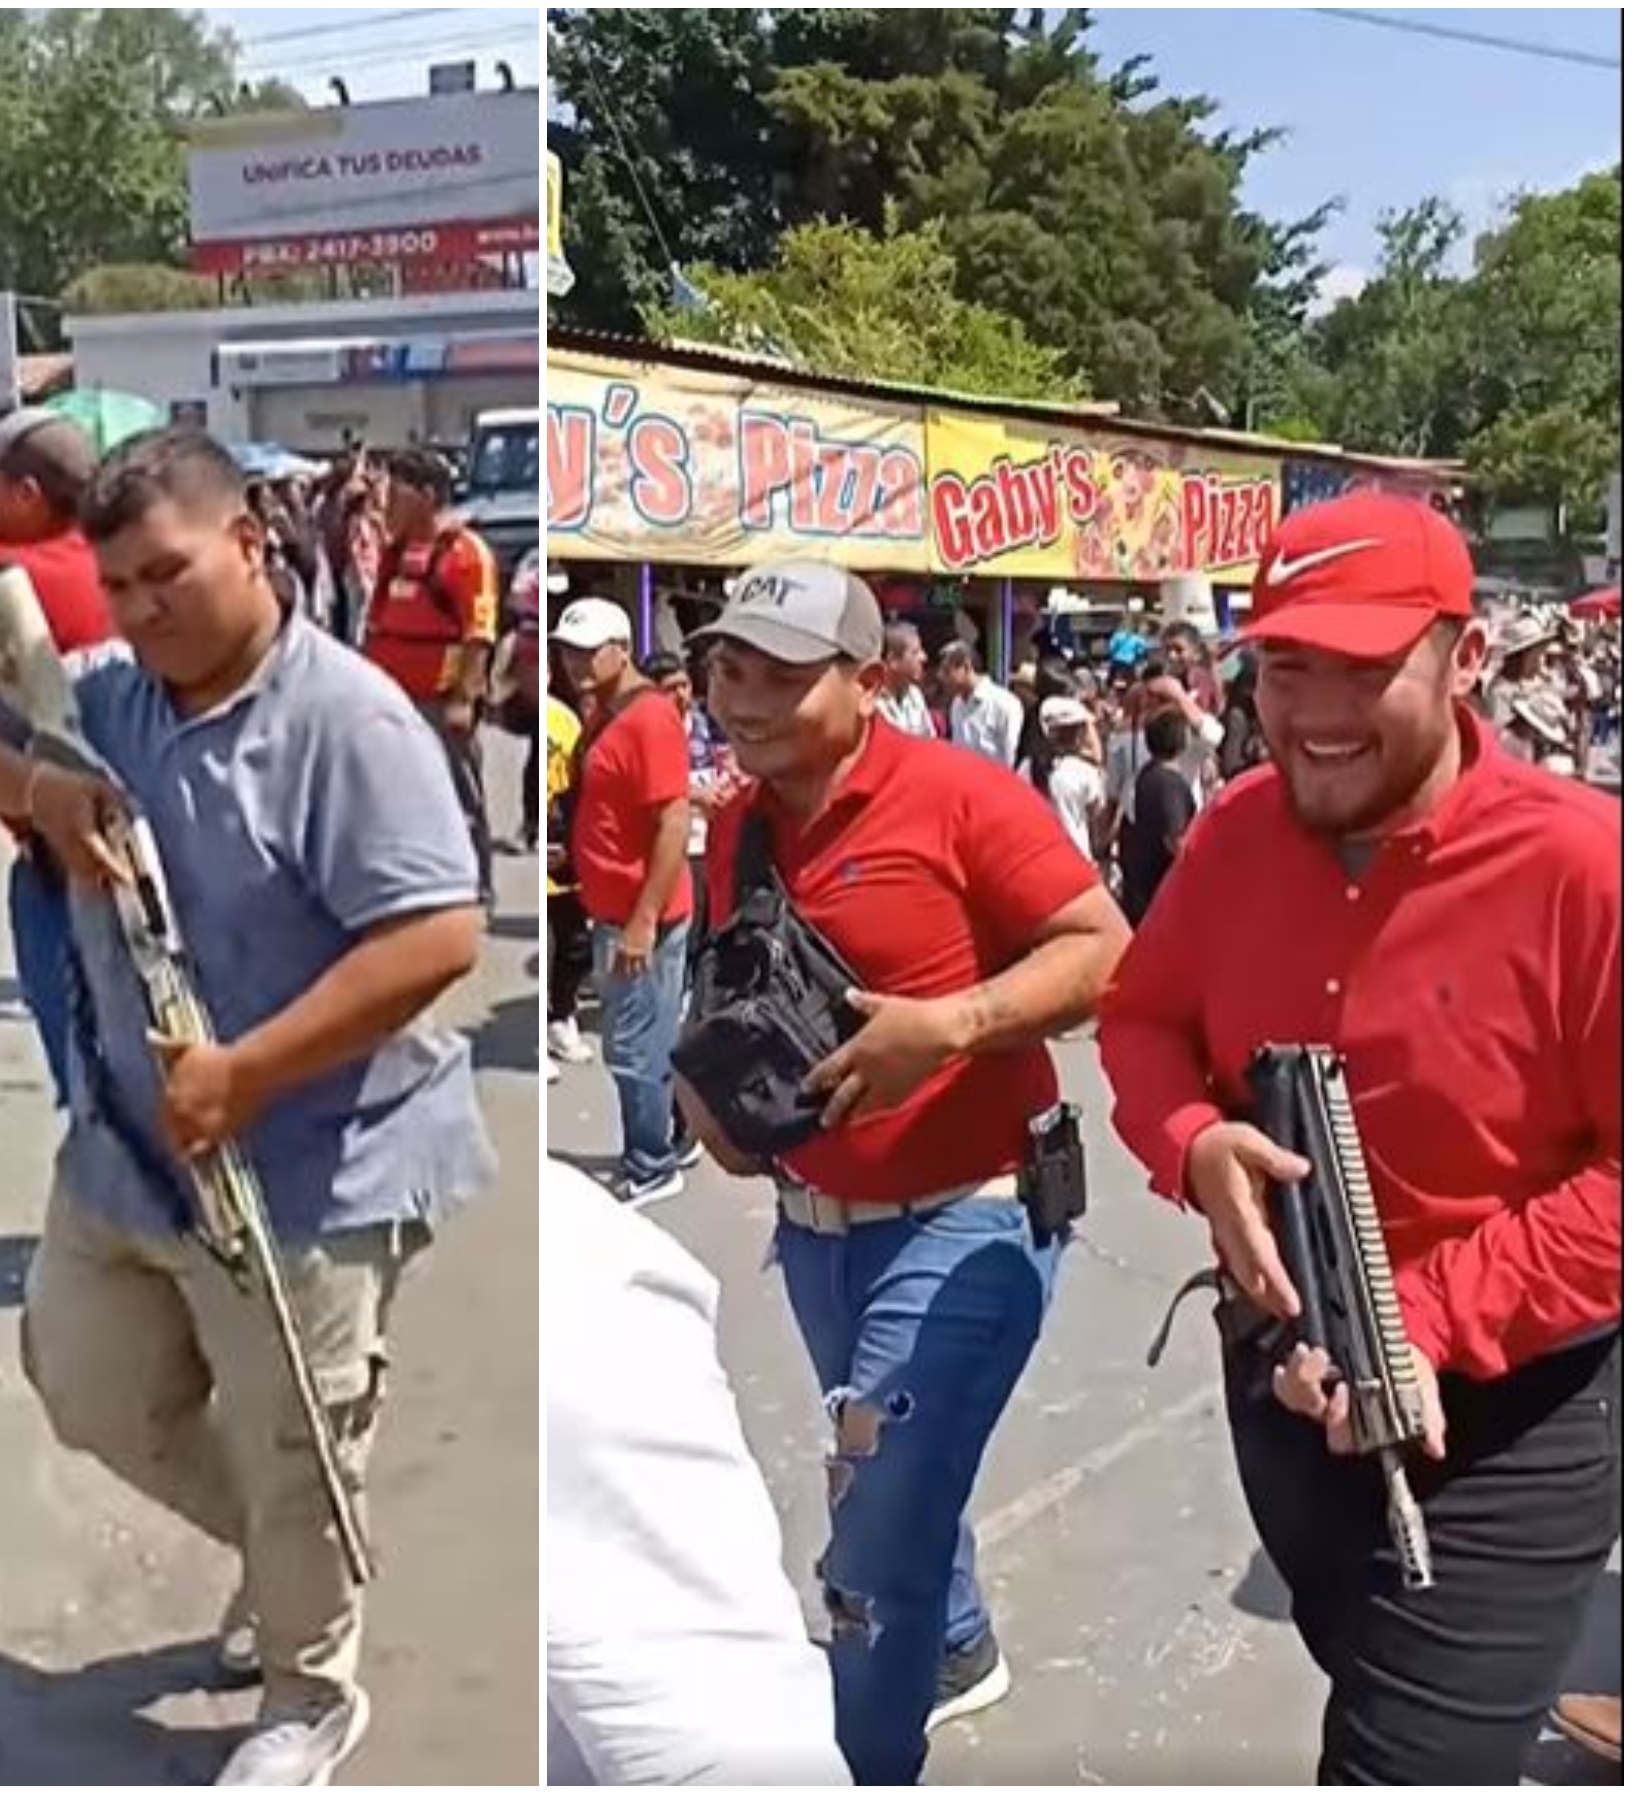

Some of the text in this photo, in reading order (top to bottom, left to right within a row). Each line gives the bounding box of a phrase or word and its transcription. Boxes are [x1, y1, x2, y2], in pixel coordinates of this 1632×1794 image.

[241, 145, 482, 184] UNIFICA TUS DEUDAS
[739, 408, 924, 538] Pizza
[930, 440, 1277, 571] Gaby's Pizza
[741, 576, 807, 606] CAT
